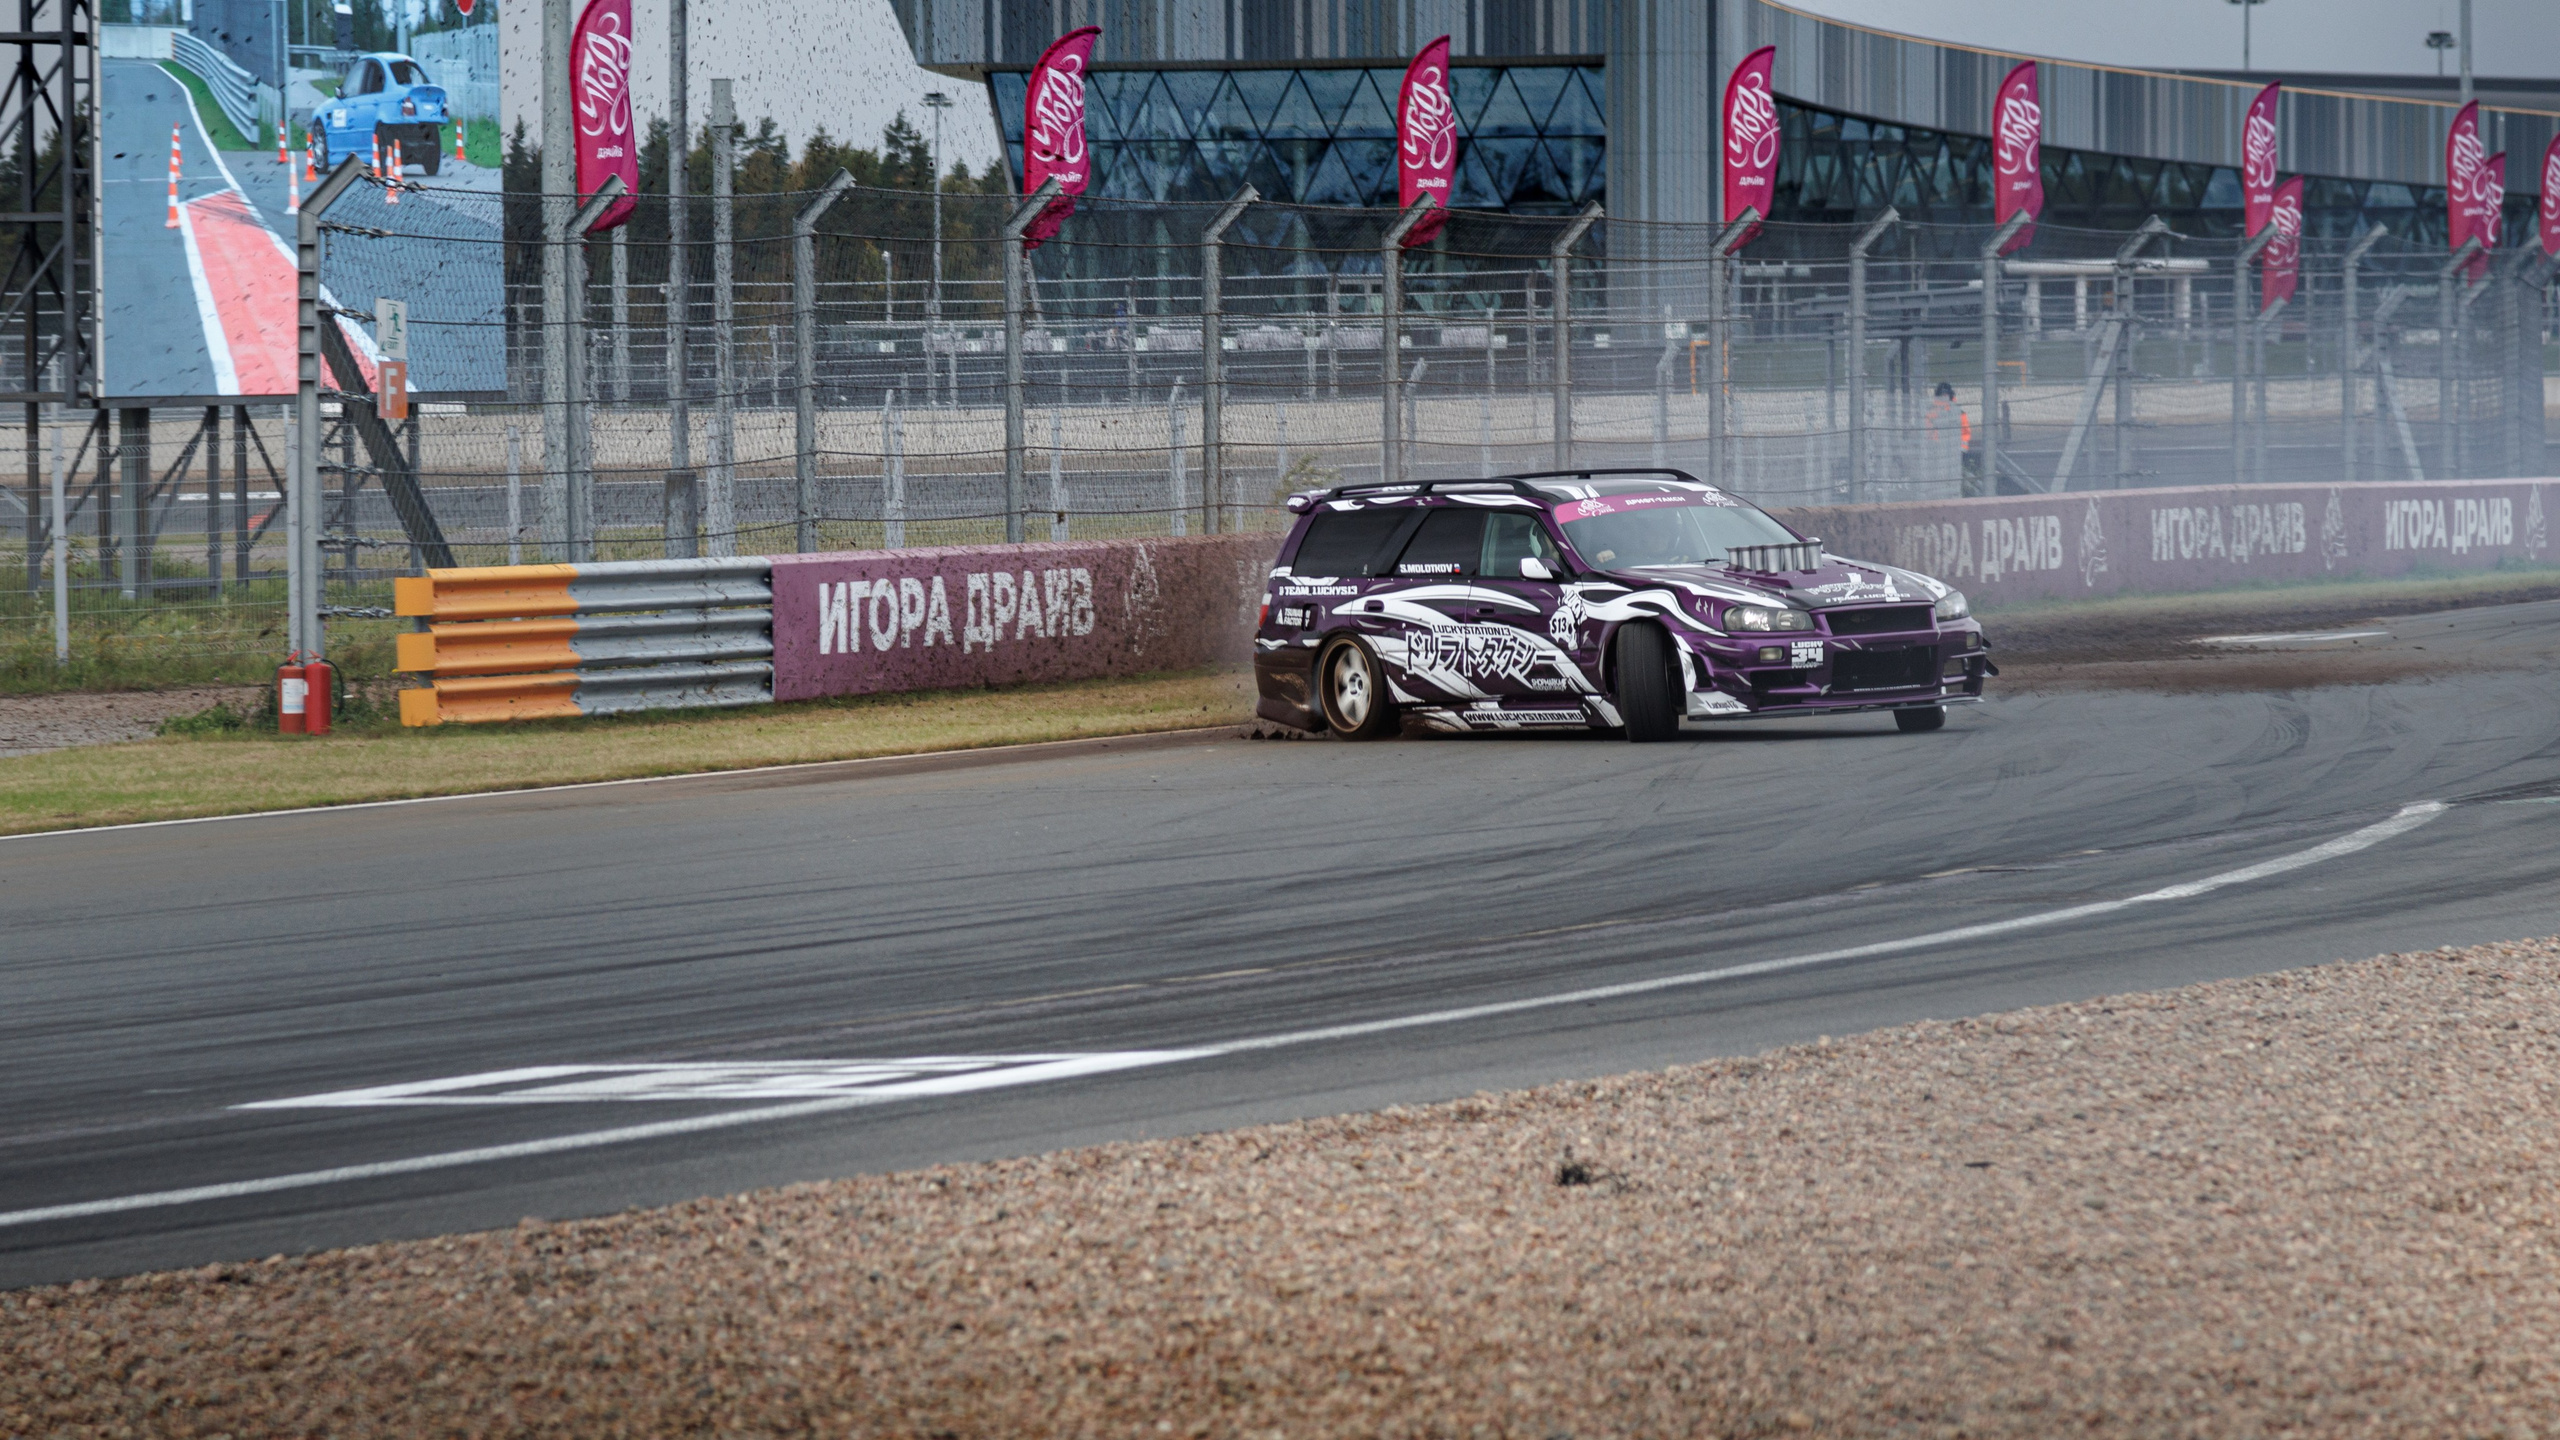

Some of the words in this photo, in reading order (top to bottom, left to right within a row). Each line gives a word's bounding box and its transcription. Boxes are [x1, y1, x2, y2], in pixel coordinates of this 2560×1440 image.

[385, 367, 398, 411] F
[2151, 506, 2226, 561] ИГОРА
[2385, 499, 2448, 550] ИГОРА
[1894, 521, 1975, 577] ИГОРА
[819, 575, 955, 655] ИГОРА
[1432, 624, 1512, 636] LUCKYSTATION13
[1551, 617, 1567, 634] S13
[1791, 641, 1823, 649] LUCKY
[1791, 648, 1823, 662] 34
[1465, 710, 1584, 722] WWW.LUCKYSTATION.RU
